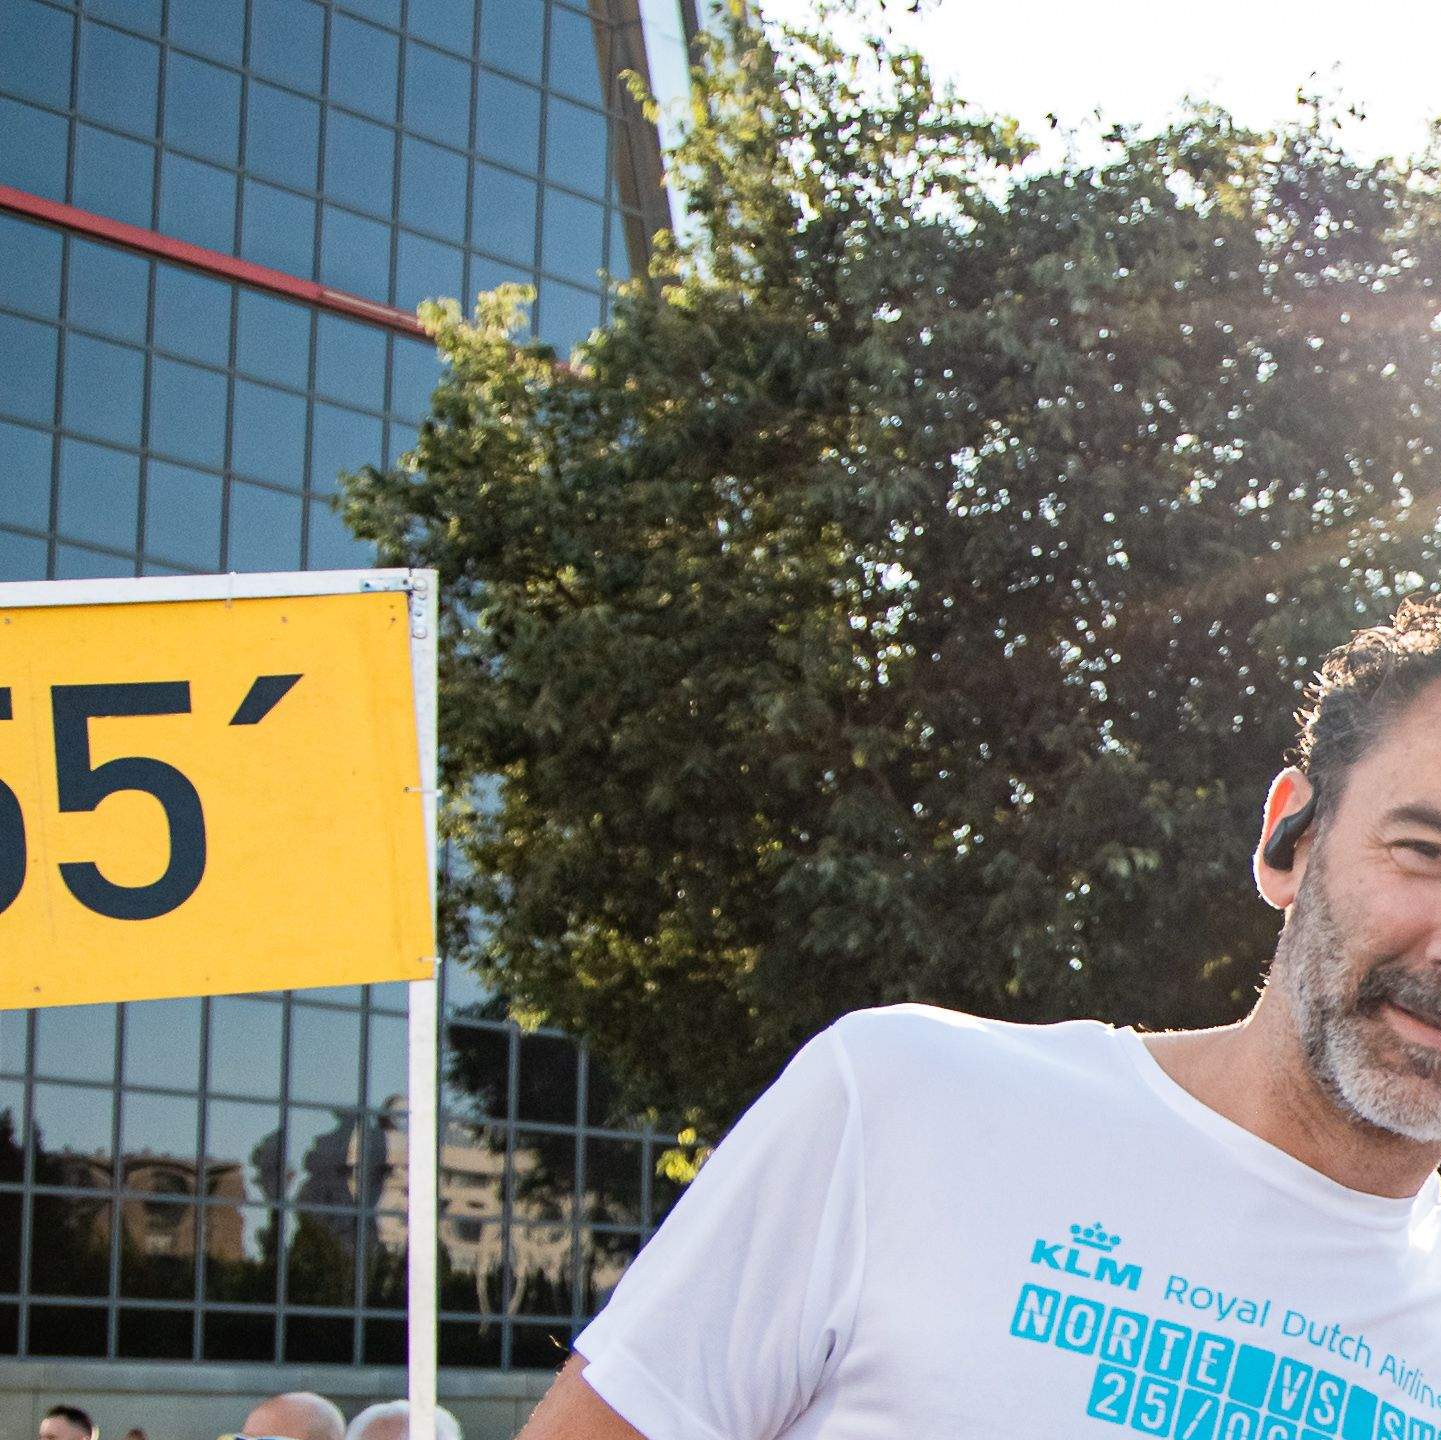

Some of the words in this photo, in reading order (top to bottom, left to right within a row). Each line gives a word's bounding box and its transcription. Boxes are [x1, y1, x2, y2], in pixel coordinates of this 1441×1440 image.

[0, 674, 304, 920] 5'
[1013, 1286, 1231, 1389] NORTE
[1275, 1359, 1343, 1431] VS
[1030, 1239, 1142, 1291] KLM
[1163, 1273, 1272, 1329] Royal
[1281, 1310, 1371, 1373] Dutch
